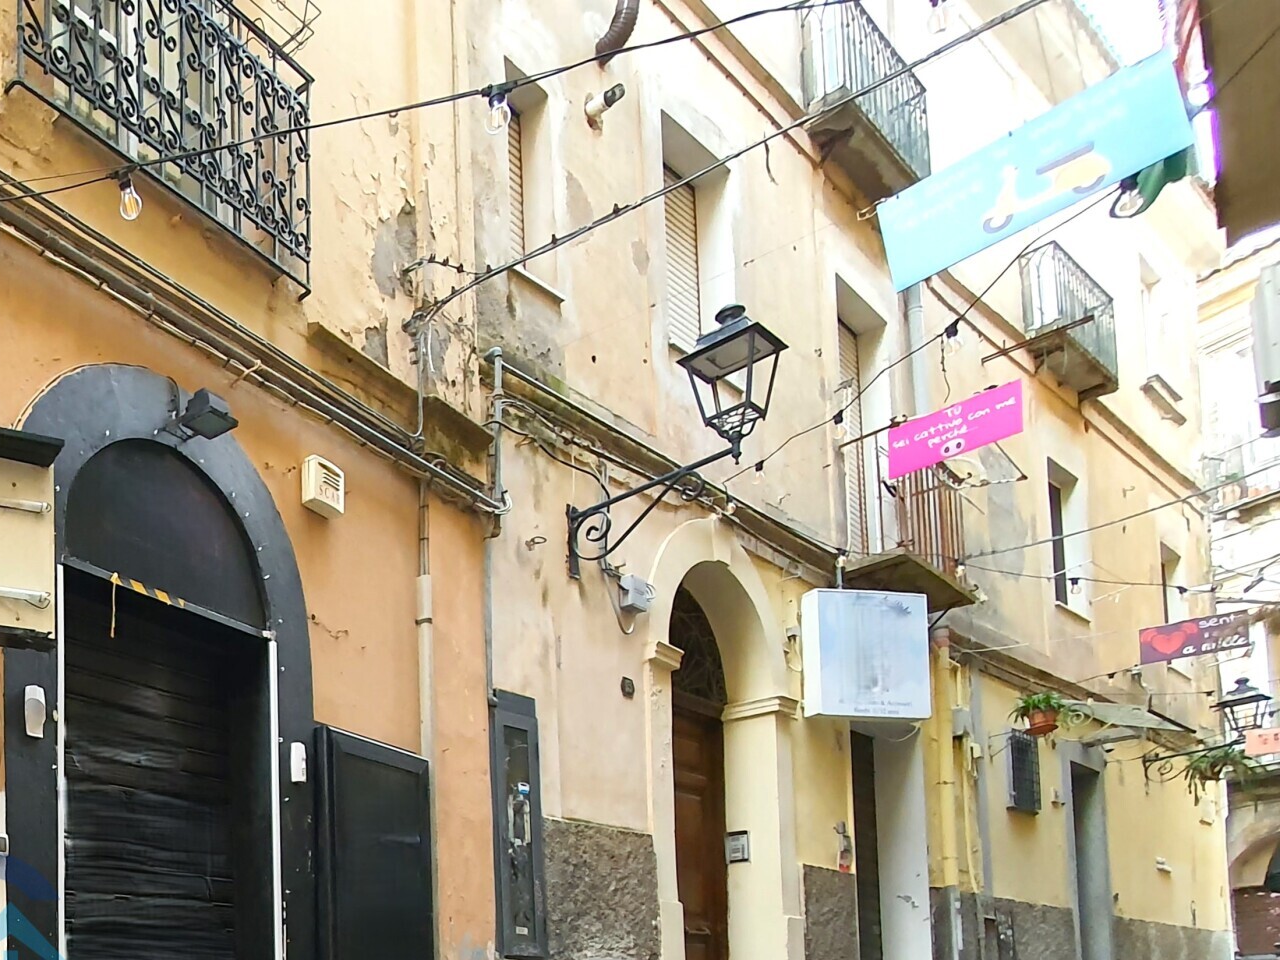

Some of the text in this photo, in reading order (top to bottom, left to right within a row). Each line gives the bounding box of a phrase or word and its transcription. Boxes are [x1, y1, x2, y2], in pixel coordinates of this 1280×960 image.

[943, 405, 963, 418] TU
[892, 438, 910, 449] sei
[914, 417, 963, 442] cattivo
[967, 407, 991, 421] con
[1182, 645, 1197, 655] a
